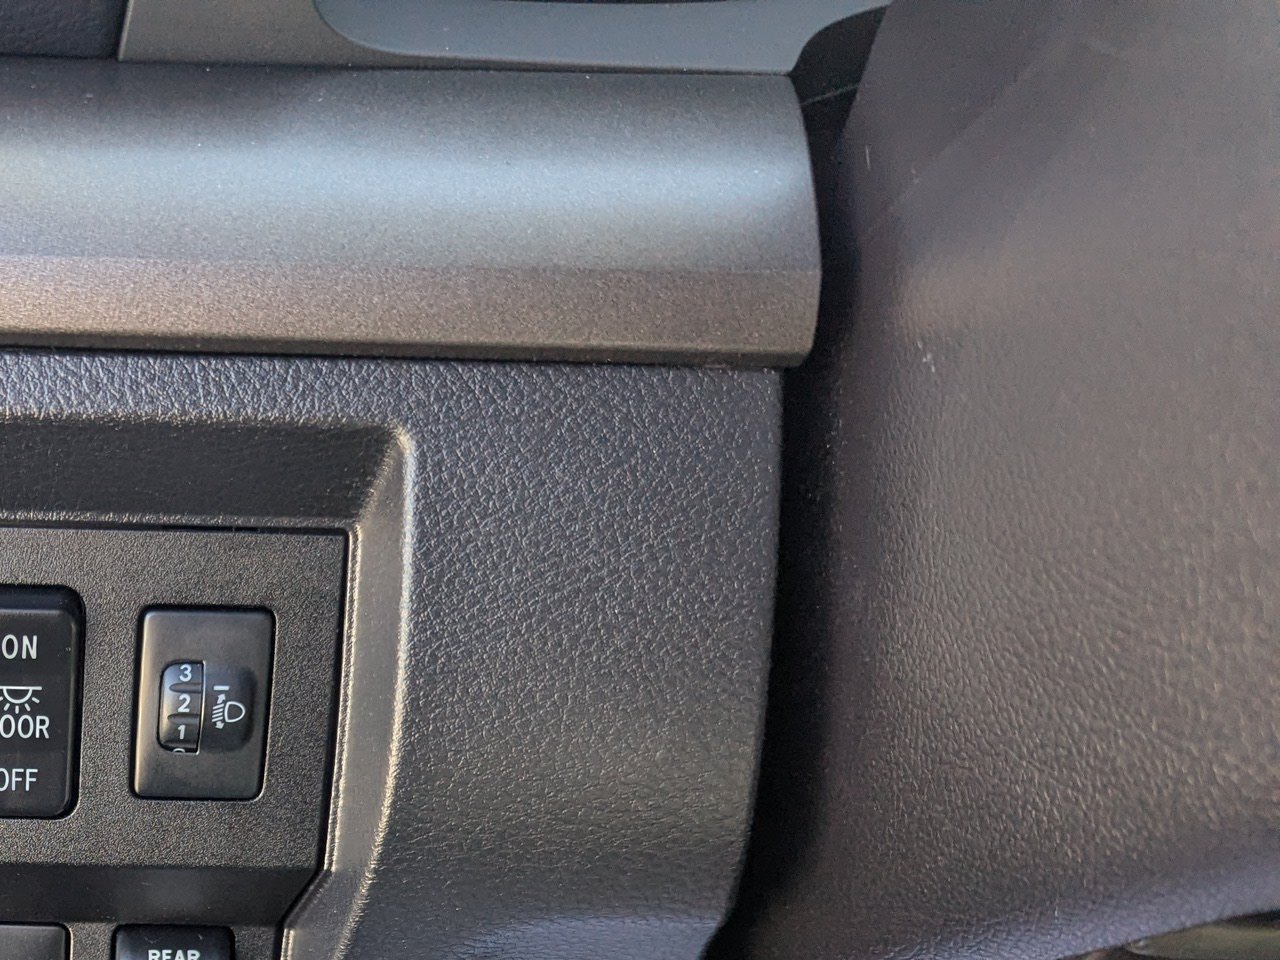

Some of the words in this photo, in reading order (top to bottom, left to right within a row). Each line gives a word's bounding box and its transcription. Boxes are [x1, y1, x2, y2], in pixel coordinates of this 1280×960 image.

[0, 633, 38, 660] ON
[178, 663, 193, 682] 3
[176, 693, 191, 713] 2
[176, 723, 187, 740] 1
